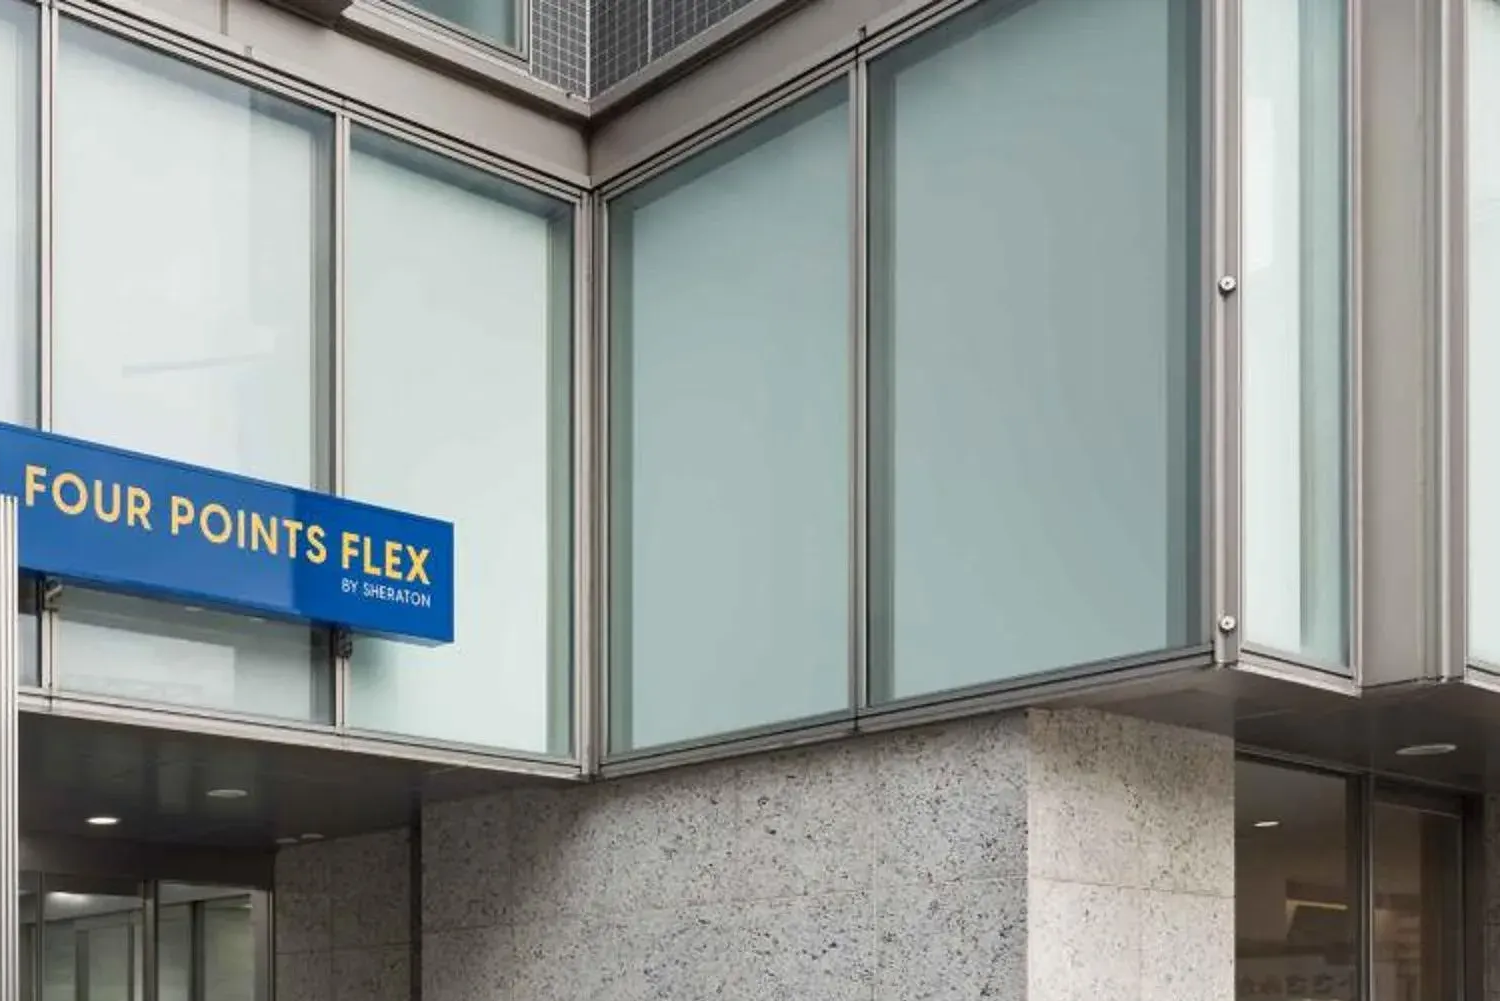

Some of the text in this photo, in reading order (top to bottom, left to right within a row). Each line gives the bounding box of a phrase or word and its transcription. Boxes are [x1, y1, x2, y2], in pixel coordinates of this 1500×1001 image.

[25, 464, 430, 585] FOUR POINTS FLEX
[341, 578, 431, 608] BY SHERATON
